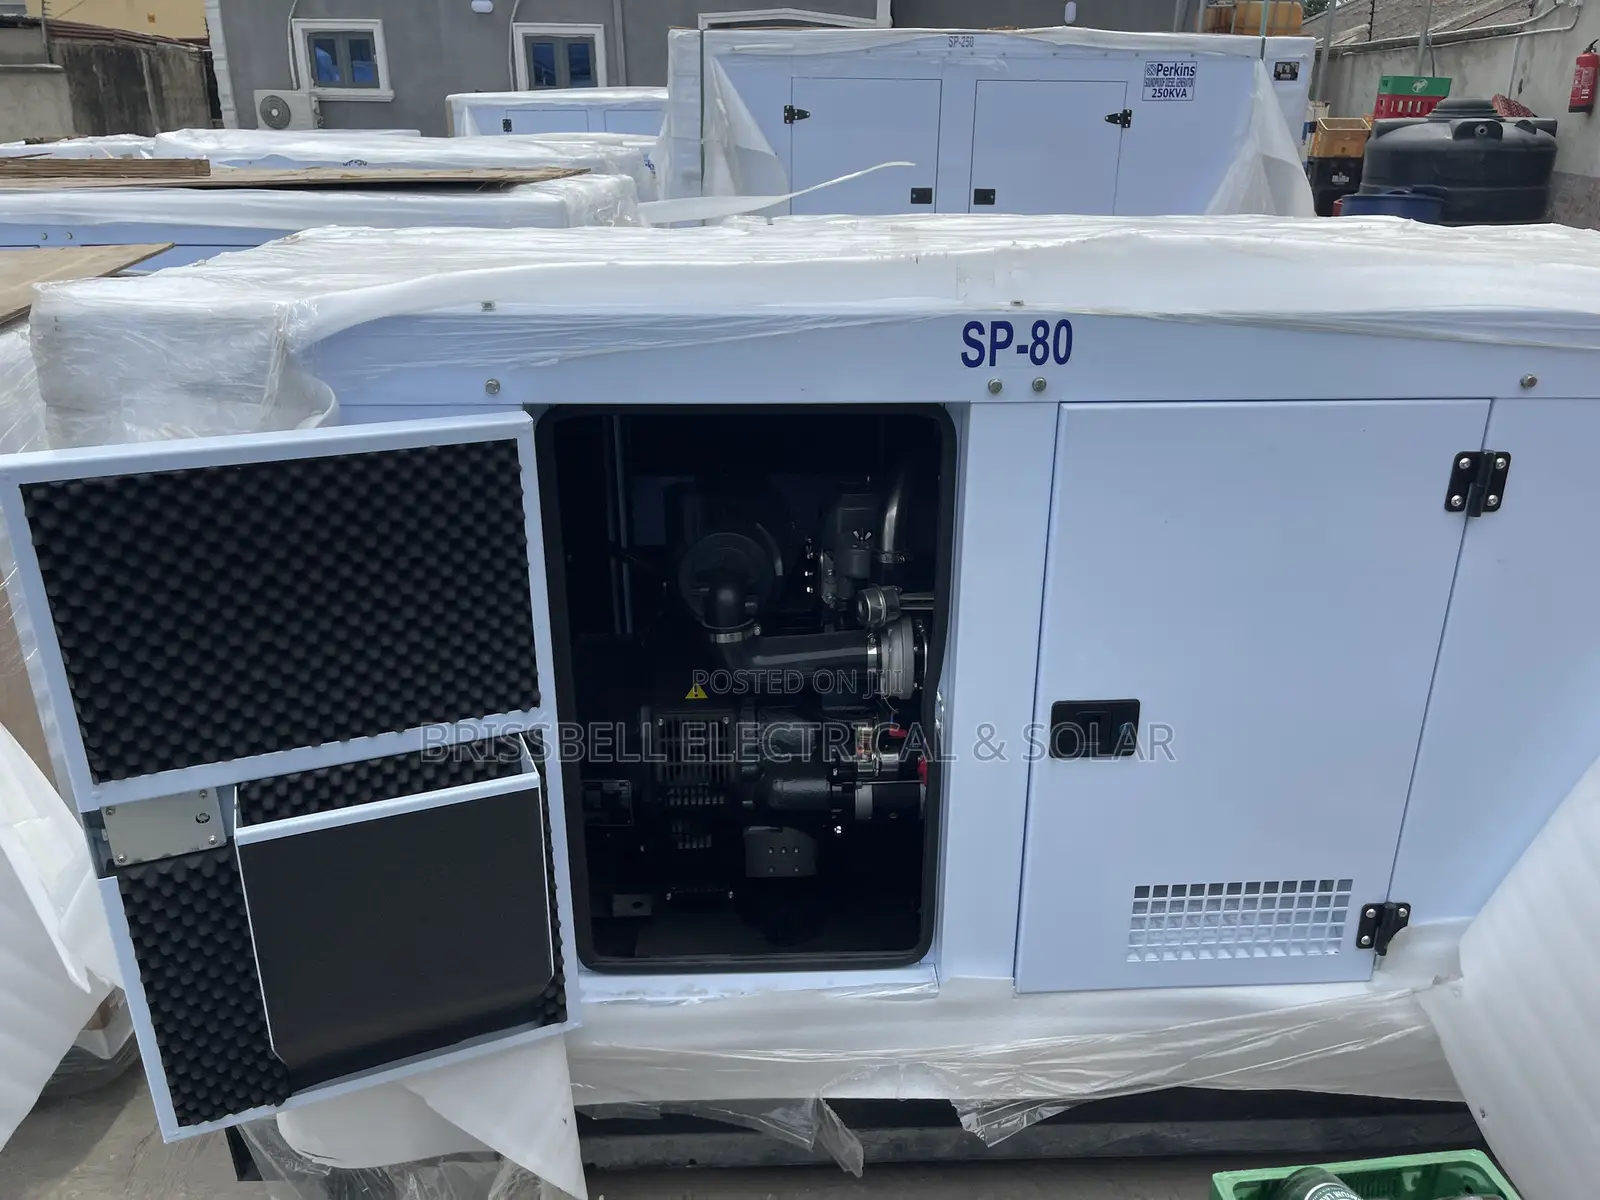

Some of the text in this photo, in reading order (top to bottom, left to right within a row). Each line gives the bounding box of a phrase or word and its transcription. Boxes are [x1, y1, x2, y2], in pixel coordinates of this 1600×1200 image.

[948, 36, 974, 48] SP-250
[1156, 62, 1196, 76] Perkins
[1152, 88, 1187, 98] 250KVA
[961, 319, 1073, 368] SP-80
